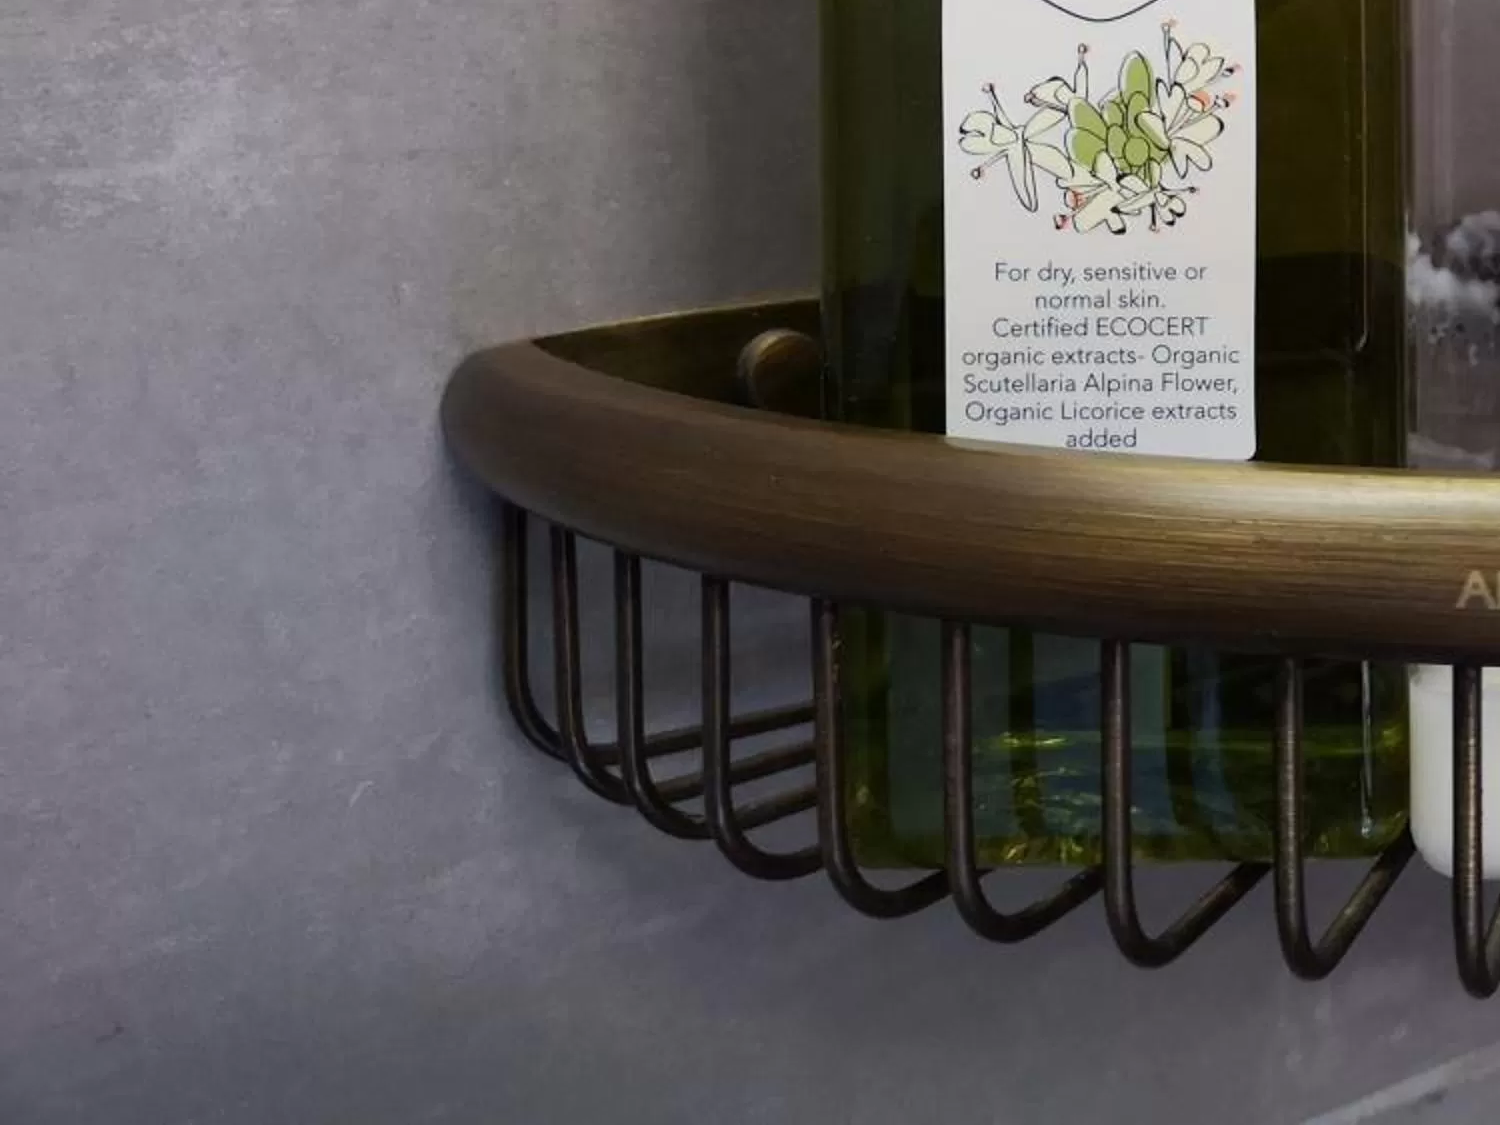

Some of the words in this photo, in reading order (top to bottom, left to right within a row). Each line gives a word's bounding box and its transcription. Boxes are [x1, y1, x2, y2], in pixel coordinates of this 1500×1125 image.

[995, 262, 1030, 282] For
[1037, 260, 1076, 286] dry,
[1083, 262, 1177, 282] sensitive
[1184, 265, 1207, 281] or
[1035, 290, 1111, 310] normal
[1118, 290, 1166, 309] skin.
[992, 317, 1089, 338] Certified
[1096, 316, 1209, 336] ECOCERT
[962, 347, 1044, 371] organic
[1051, 347, 1145, 365] extracts-
[1151, 344, 1241, 369] Organic
[964, 373, 1076, 394] Scutellaria
[1083, 373, 1153, 396] Alpina
[1161, 372, 1238, 395] Flower,
[965, 401, 1053, 425] Organic
[1061, 401, 1144, 421] Licorice
[1151, 403, 1238, 420] extracts
[1065, 428, 1137, 448] added
